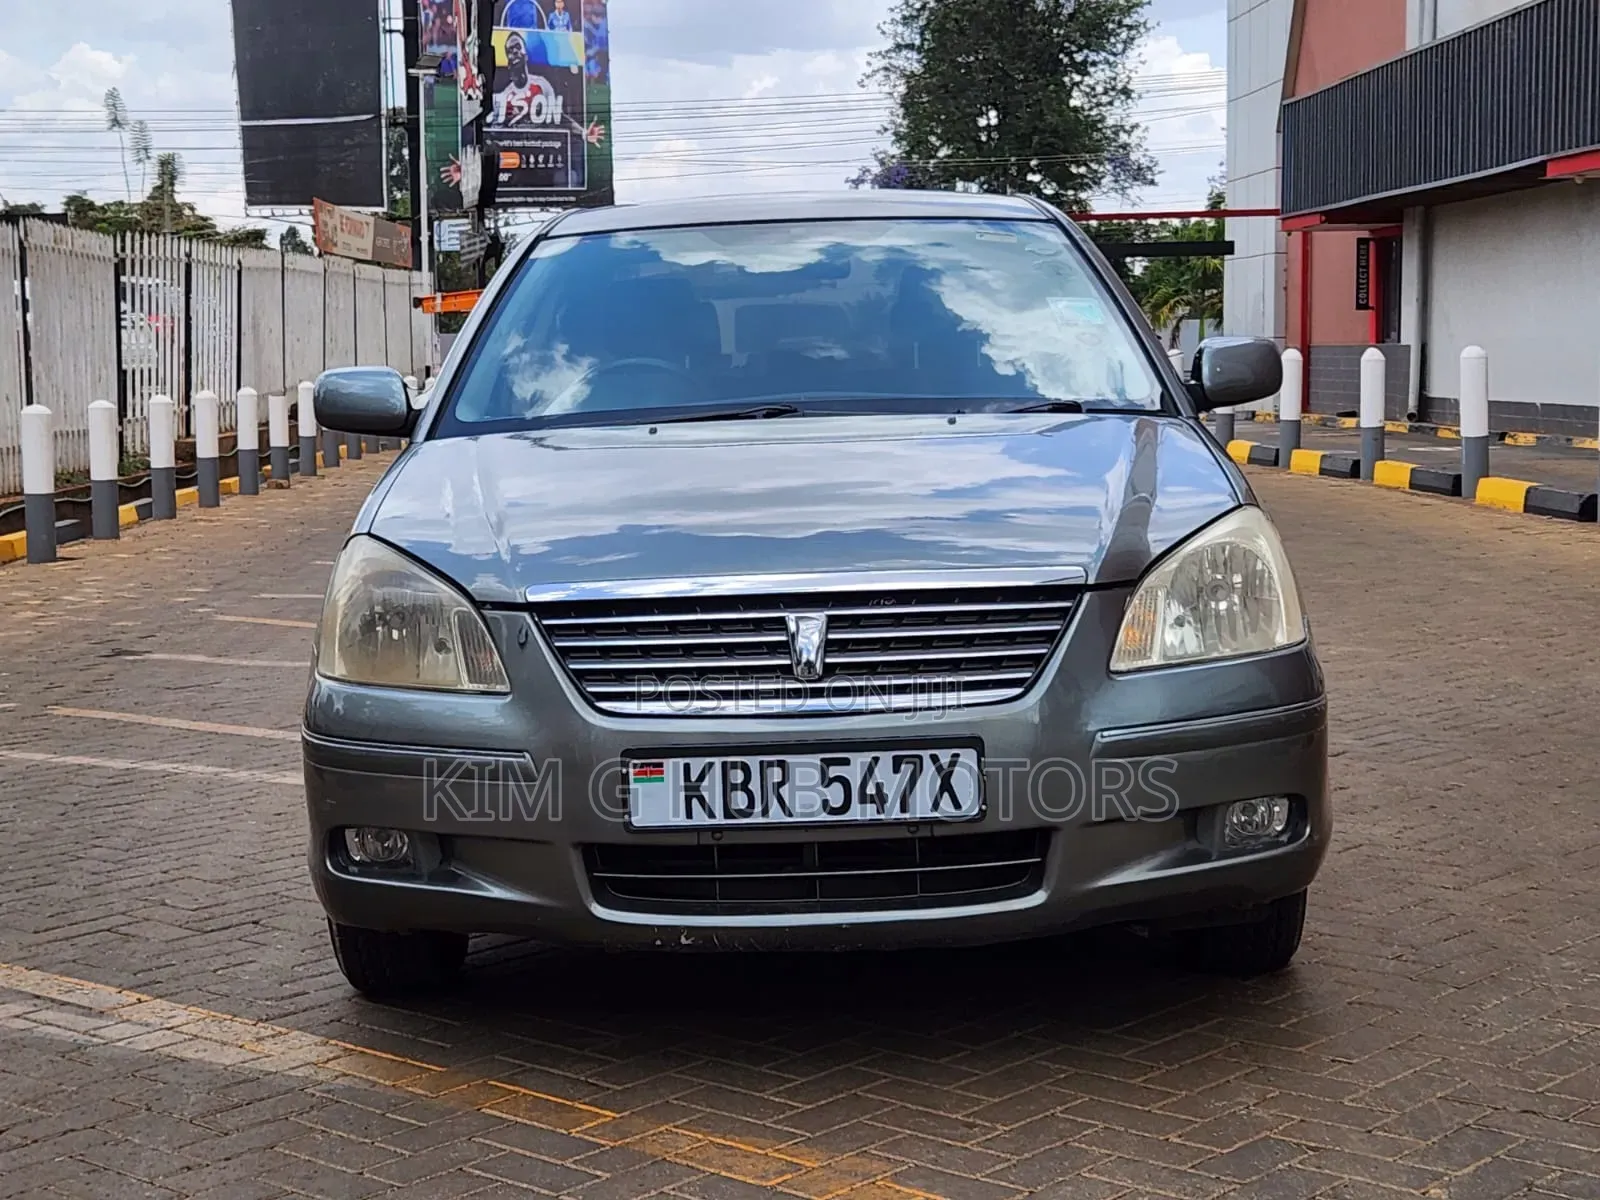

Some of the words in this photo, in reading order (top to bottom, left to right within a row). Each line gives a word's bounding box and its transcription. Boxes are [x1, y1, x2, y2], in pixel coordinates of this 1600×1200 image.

[1358, 268, 1368, 304] COLLECT
[683, 758, 794, 820] KBR
[819, 752, 963, 816] 547X
